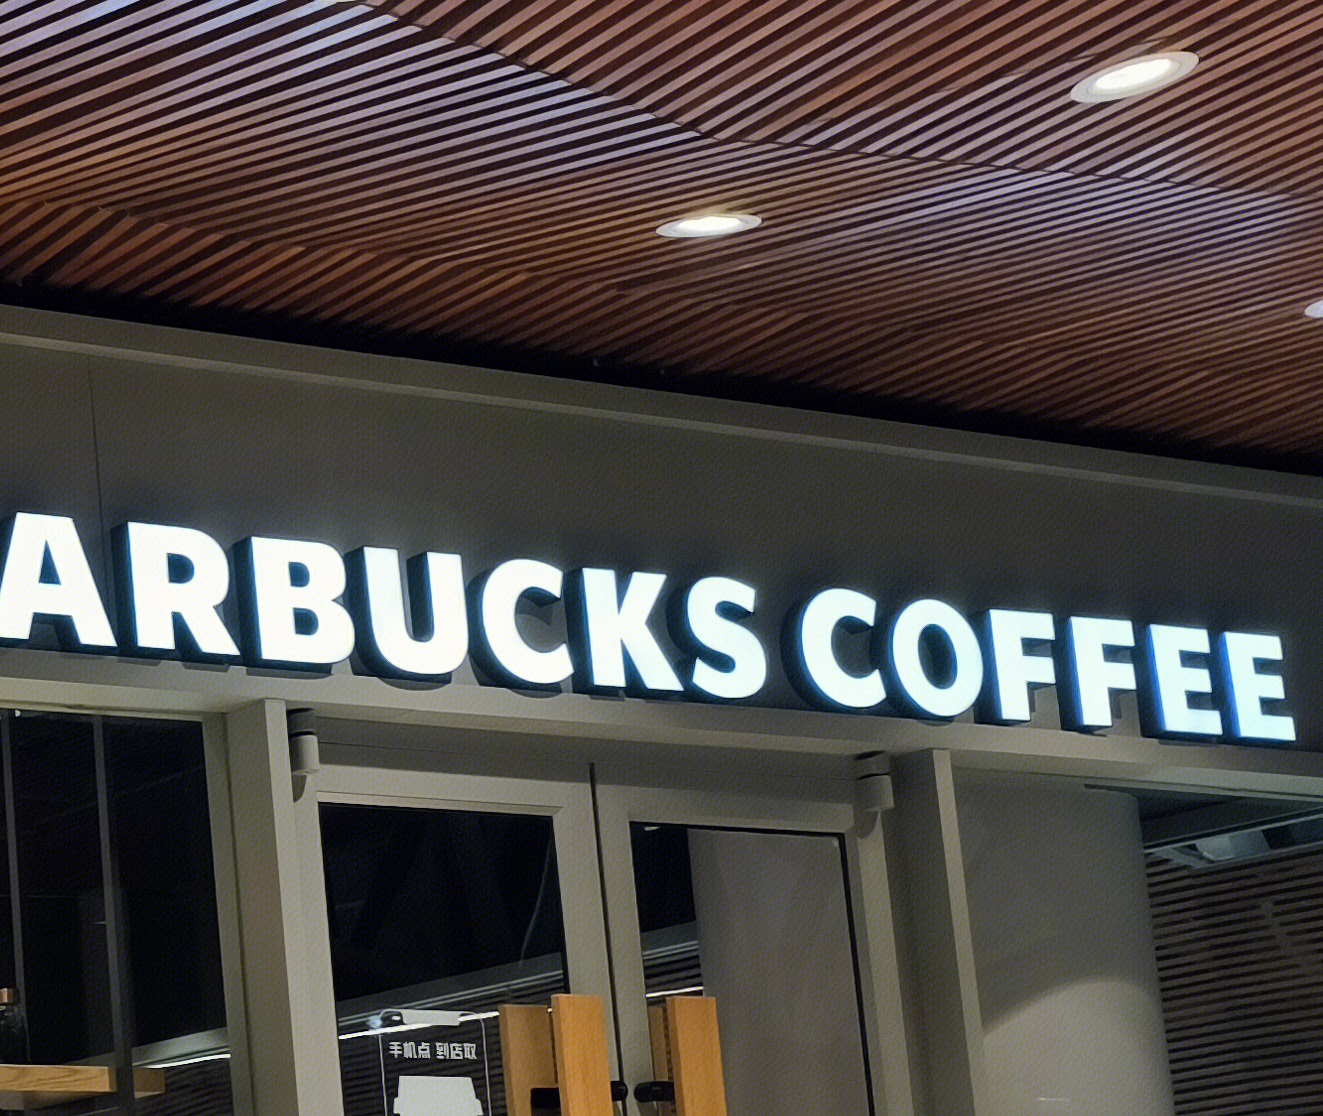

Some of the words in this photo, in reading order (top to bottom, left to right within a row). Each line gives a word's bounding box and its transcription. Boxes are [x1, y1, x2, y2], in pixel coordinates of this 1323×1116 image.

[800, 588, 1297, 742] COFFEE
[388, 1041, 431, 1059] 手机点
[435, 1042, 478, 1060] 到店取
